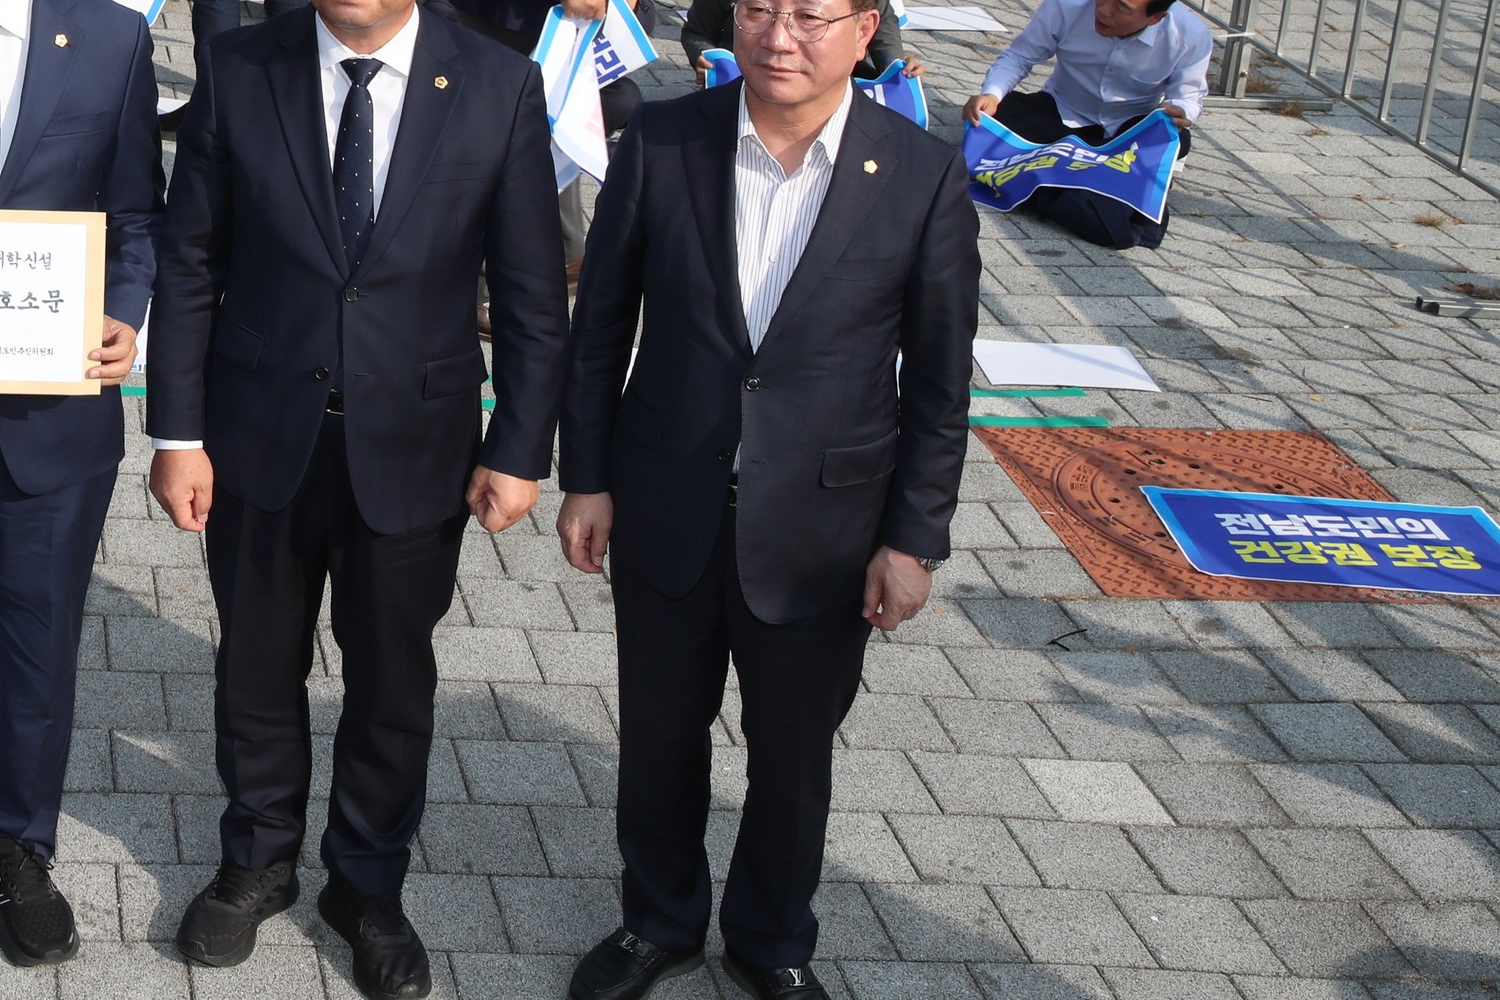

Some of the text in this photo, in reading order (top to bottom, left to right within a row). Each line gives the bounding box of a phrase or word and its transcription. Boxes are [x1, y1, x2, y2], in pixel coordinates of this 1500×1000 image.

[24, 251, 53, 271] 신설
[1213, 513, 1451, 540] 전남도민의
[1228, 540, 1482, 570] 건강권 보장
